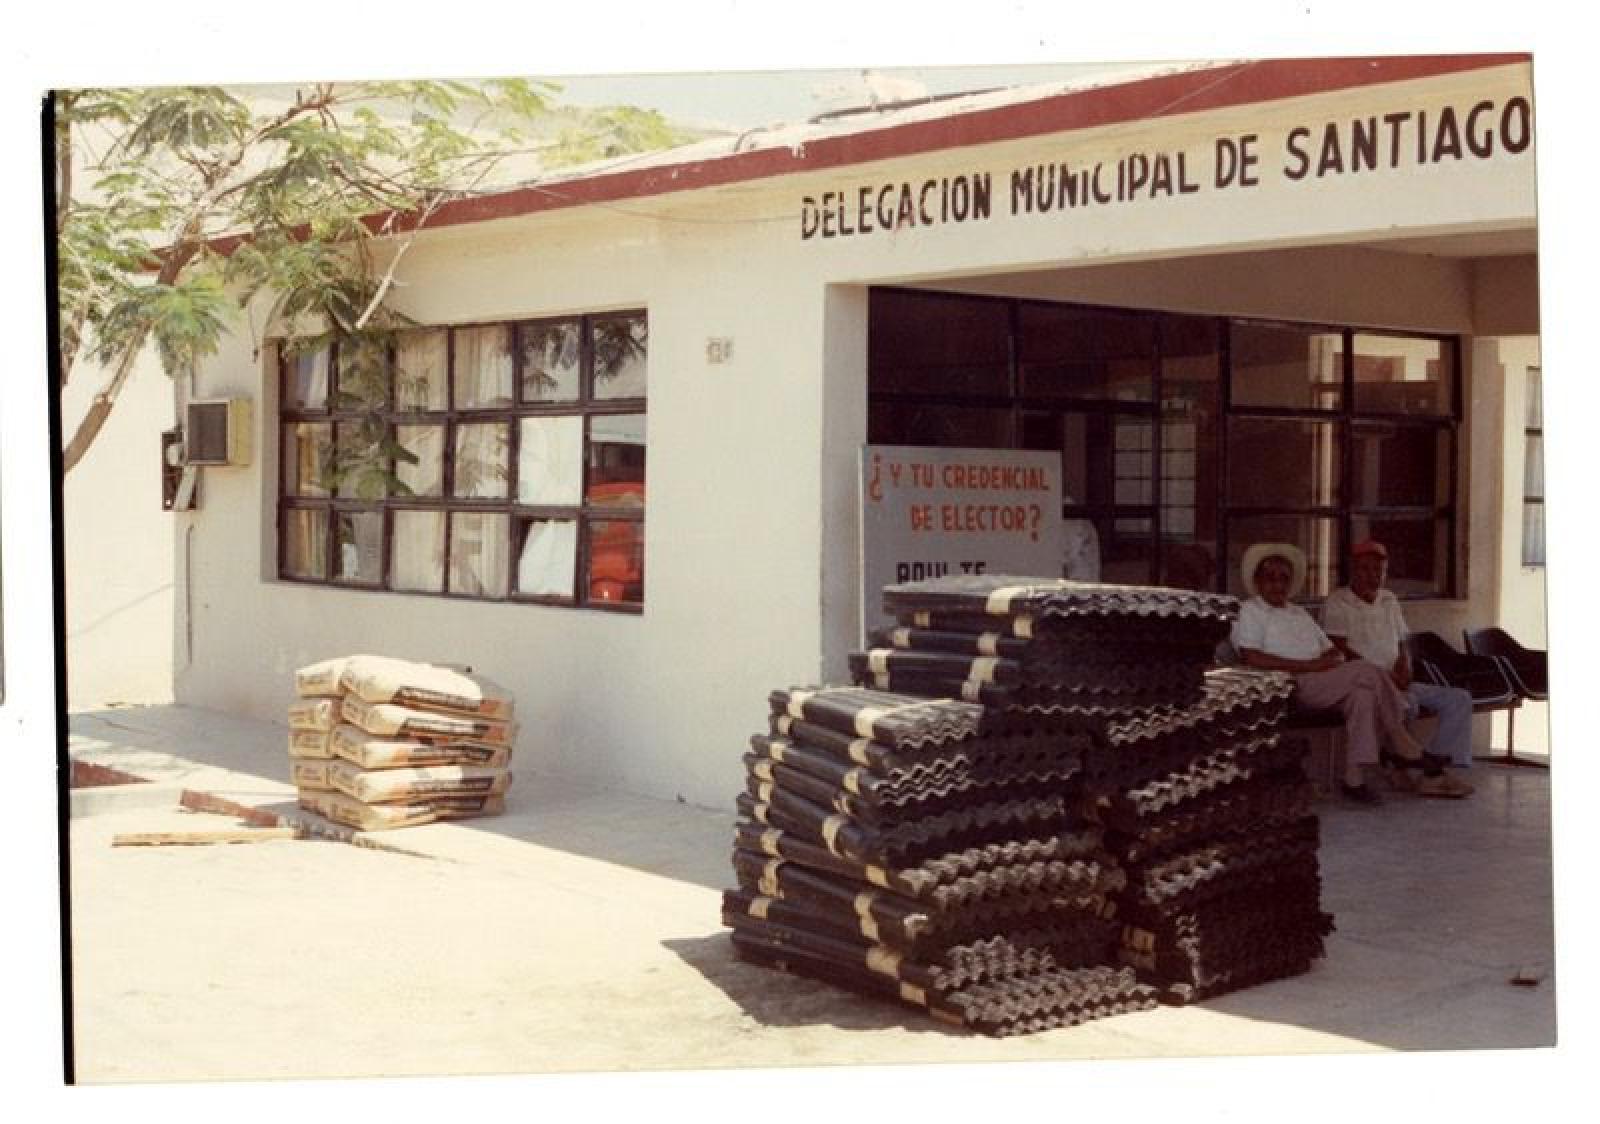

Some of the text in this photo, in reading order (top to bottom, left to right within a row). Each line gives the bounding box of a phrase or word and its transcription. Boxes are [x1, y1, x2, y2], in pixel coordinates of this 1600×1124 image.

[801, 96, 1532, 241] DELEGACION MUNICIPAL DE SANTIAGO
[911, 464, 934, 488] TU
[943, 465, 1049, 491] CREDENCIAL
[911, 504, 933, 531] DE
